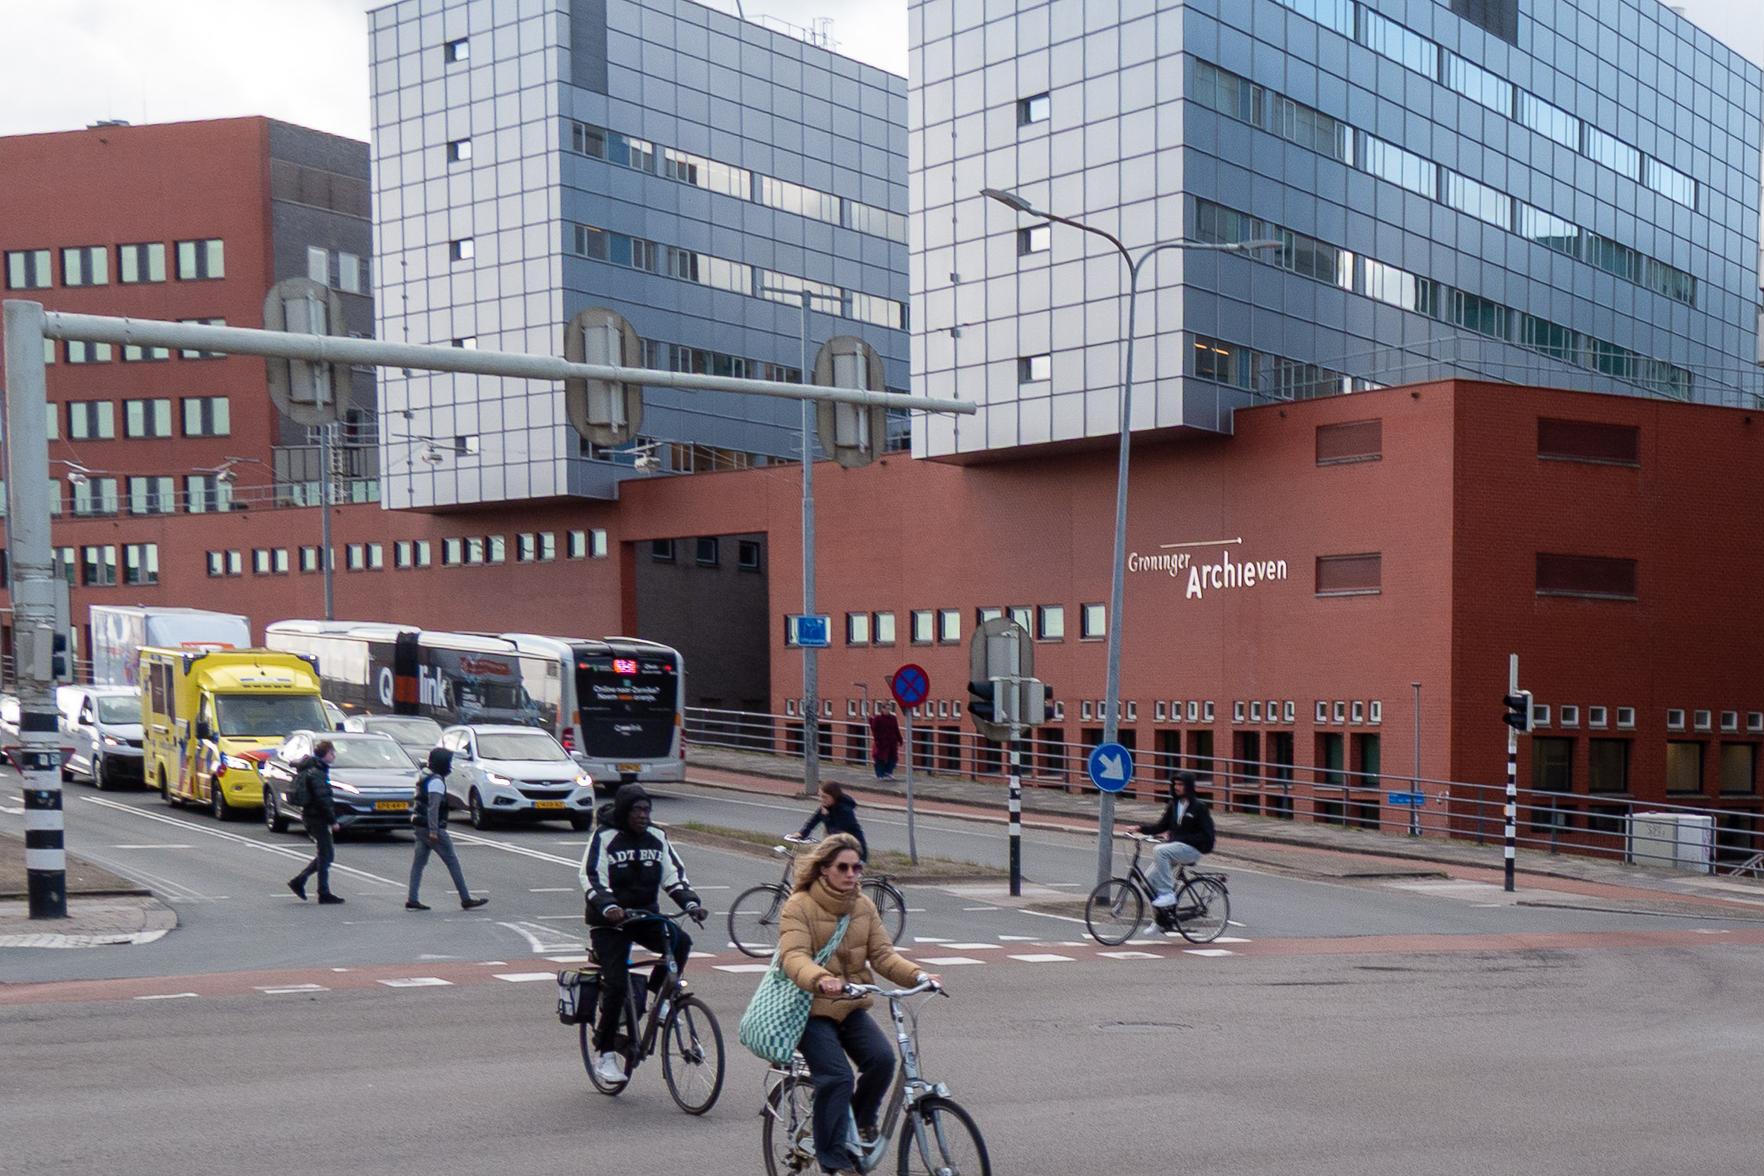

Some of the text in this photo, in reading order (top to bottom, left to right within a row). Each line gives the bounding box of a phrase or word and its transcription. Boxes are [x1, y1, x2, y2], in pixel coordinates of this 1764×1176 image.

[1128, 552, 1191, 578] Groninger
[1185, 551, 1288, 600] Archieven
[419, 664, 448, 708] link
